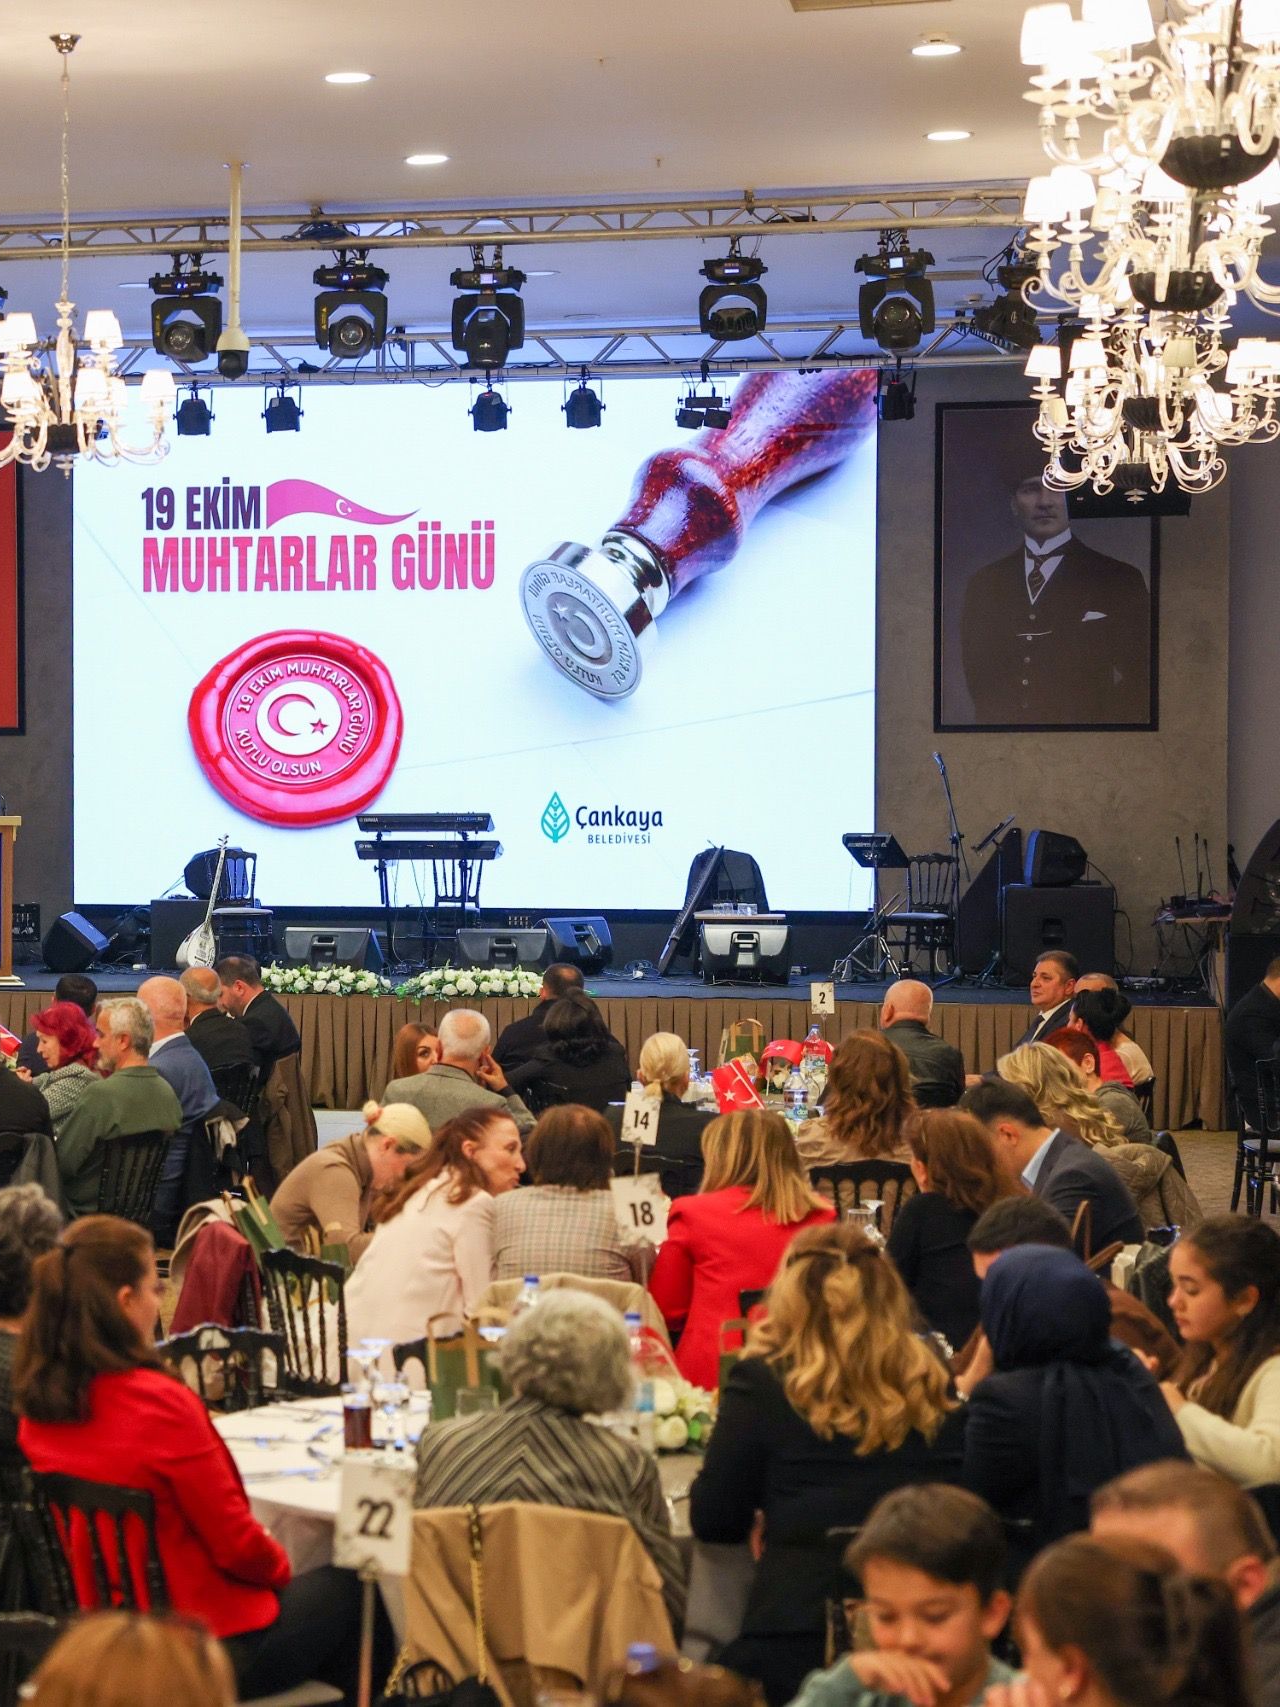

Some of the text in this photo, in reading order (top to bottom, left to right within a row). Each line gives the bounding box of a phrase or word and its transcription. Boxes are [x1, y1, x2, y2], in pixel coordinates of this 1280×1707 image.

[141, 476, 261, 530] 19 EKİM
[143, 520, 495, 592] MUHTARLAR GÜNÜ
[237, 662, 366, 756] 19 EKİM MUHTARLAR GÜNÜ
[236, 728, 322, 777] KUTLU OLSUN
[576, 805, 663, 831] Çankaya
[587, 832, 651, 844] BELEDİYESİ
[819, 992, 826, 1004] 2
[634, 1110, 650, 1130] 14
[629, 1201, 654, 1227] 18
[357, 1498, 395, 1539] 22
